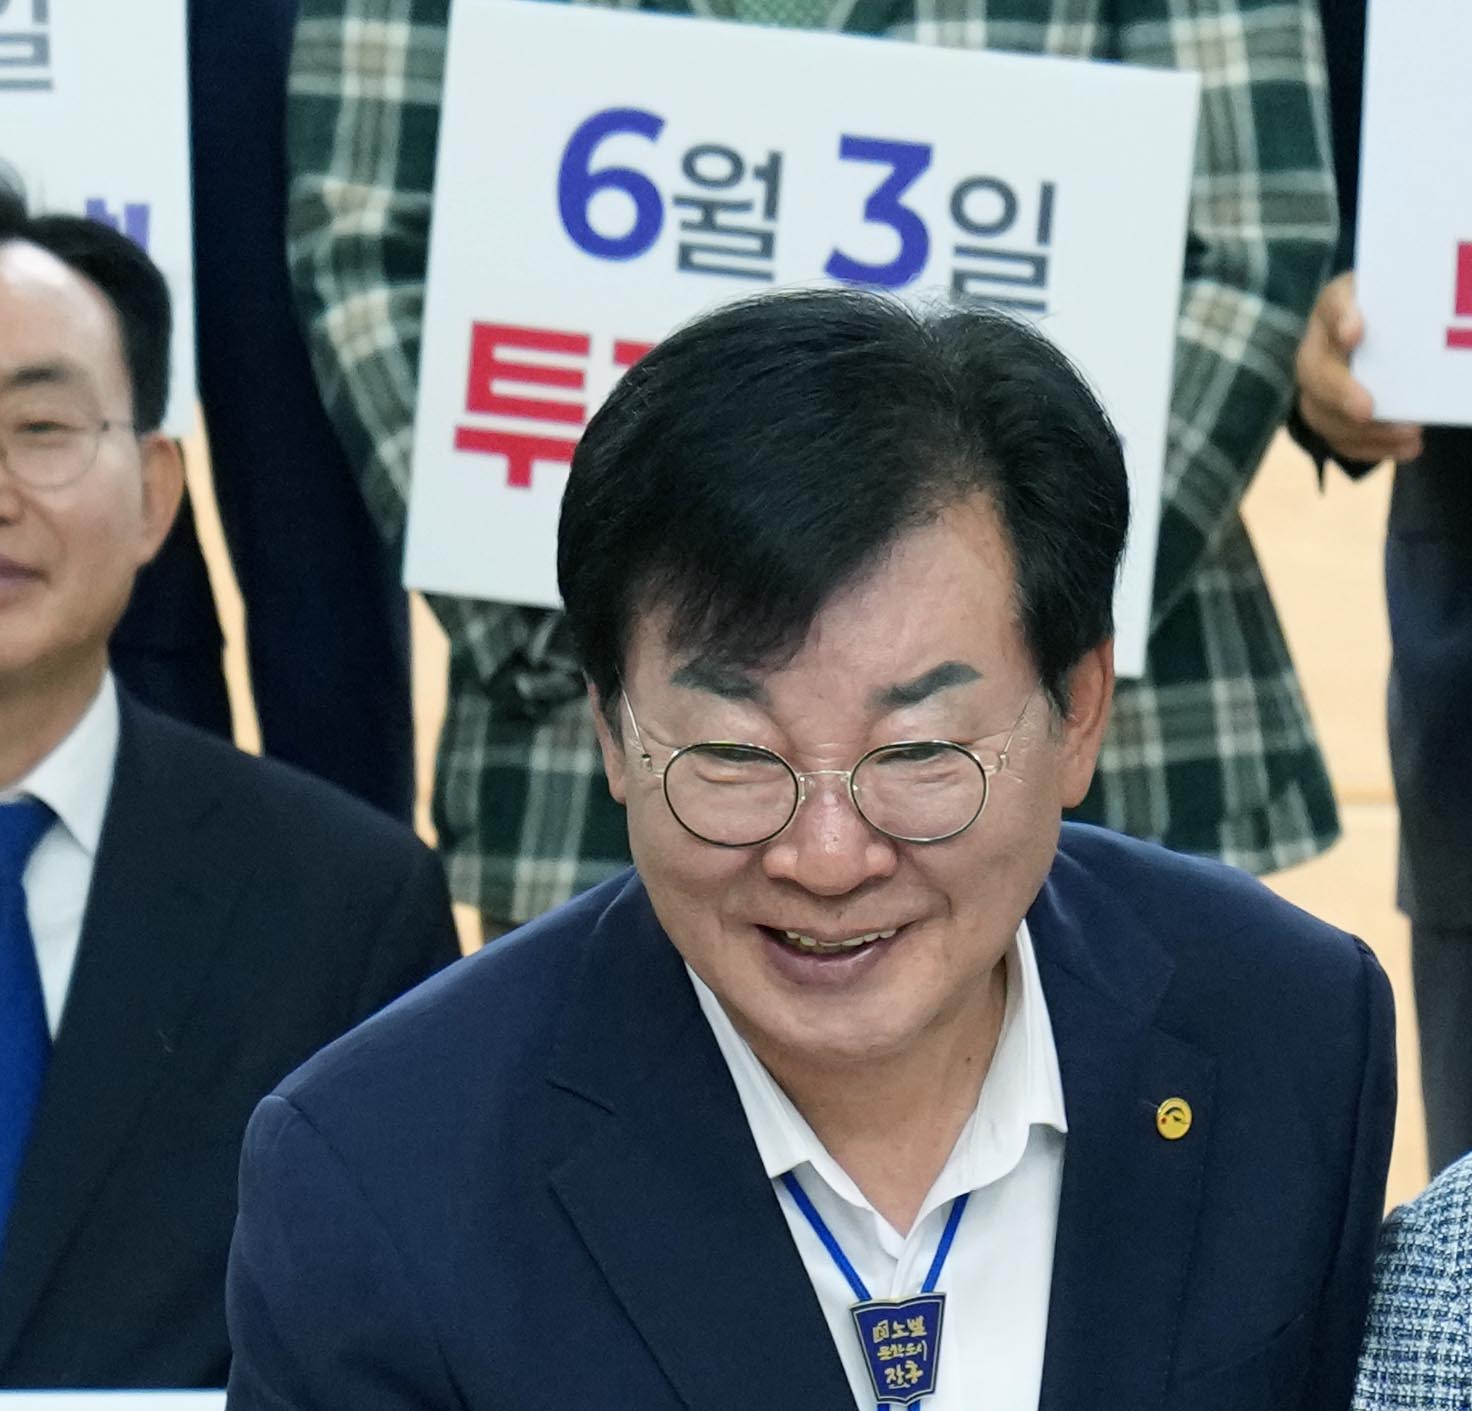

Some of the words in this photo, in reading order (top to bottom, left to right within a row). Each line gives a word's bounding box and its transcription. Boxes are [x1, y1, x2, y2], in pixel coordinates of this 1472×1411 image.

[556, 106, 785, 281] 6월
[824, 133, 1058, 314] 3일
[453, 320, 656, 488] 투
